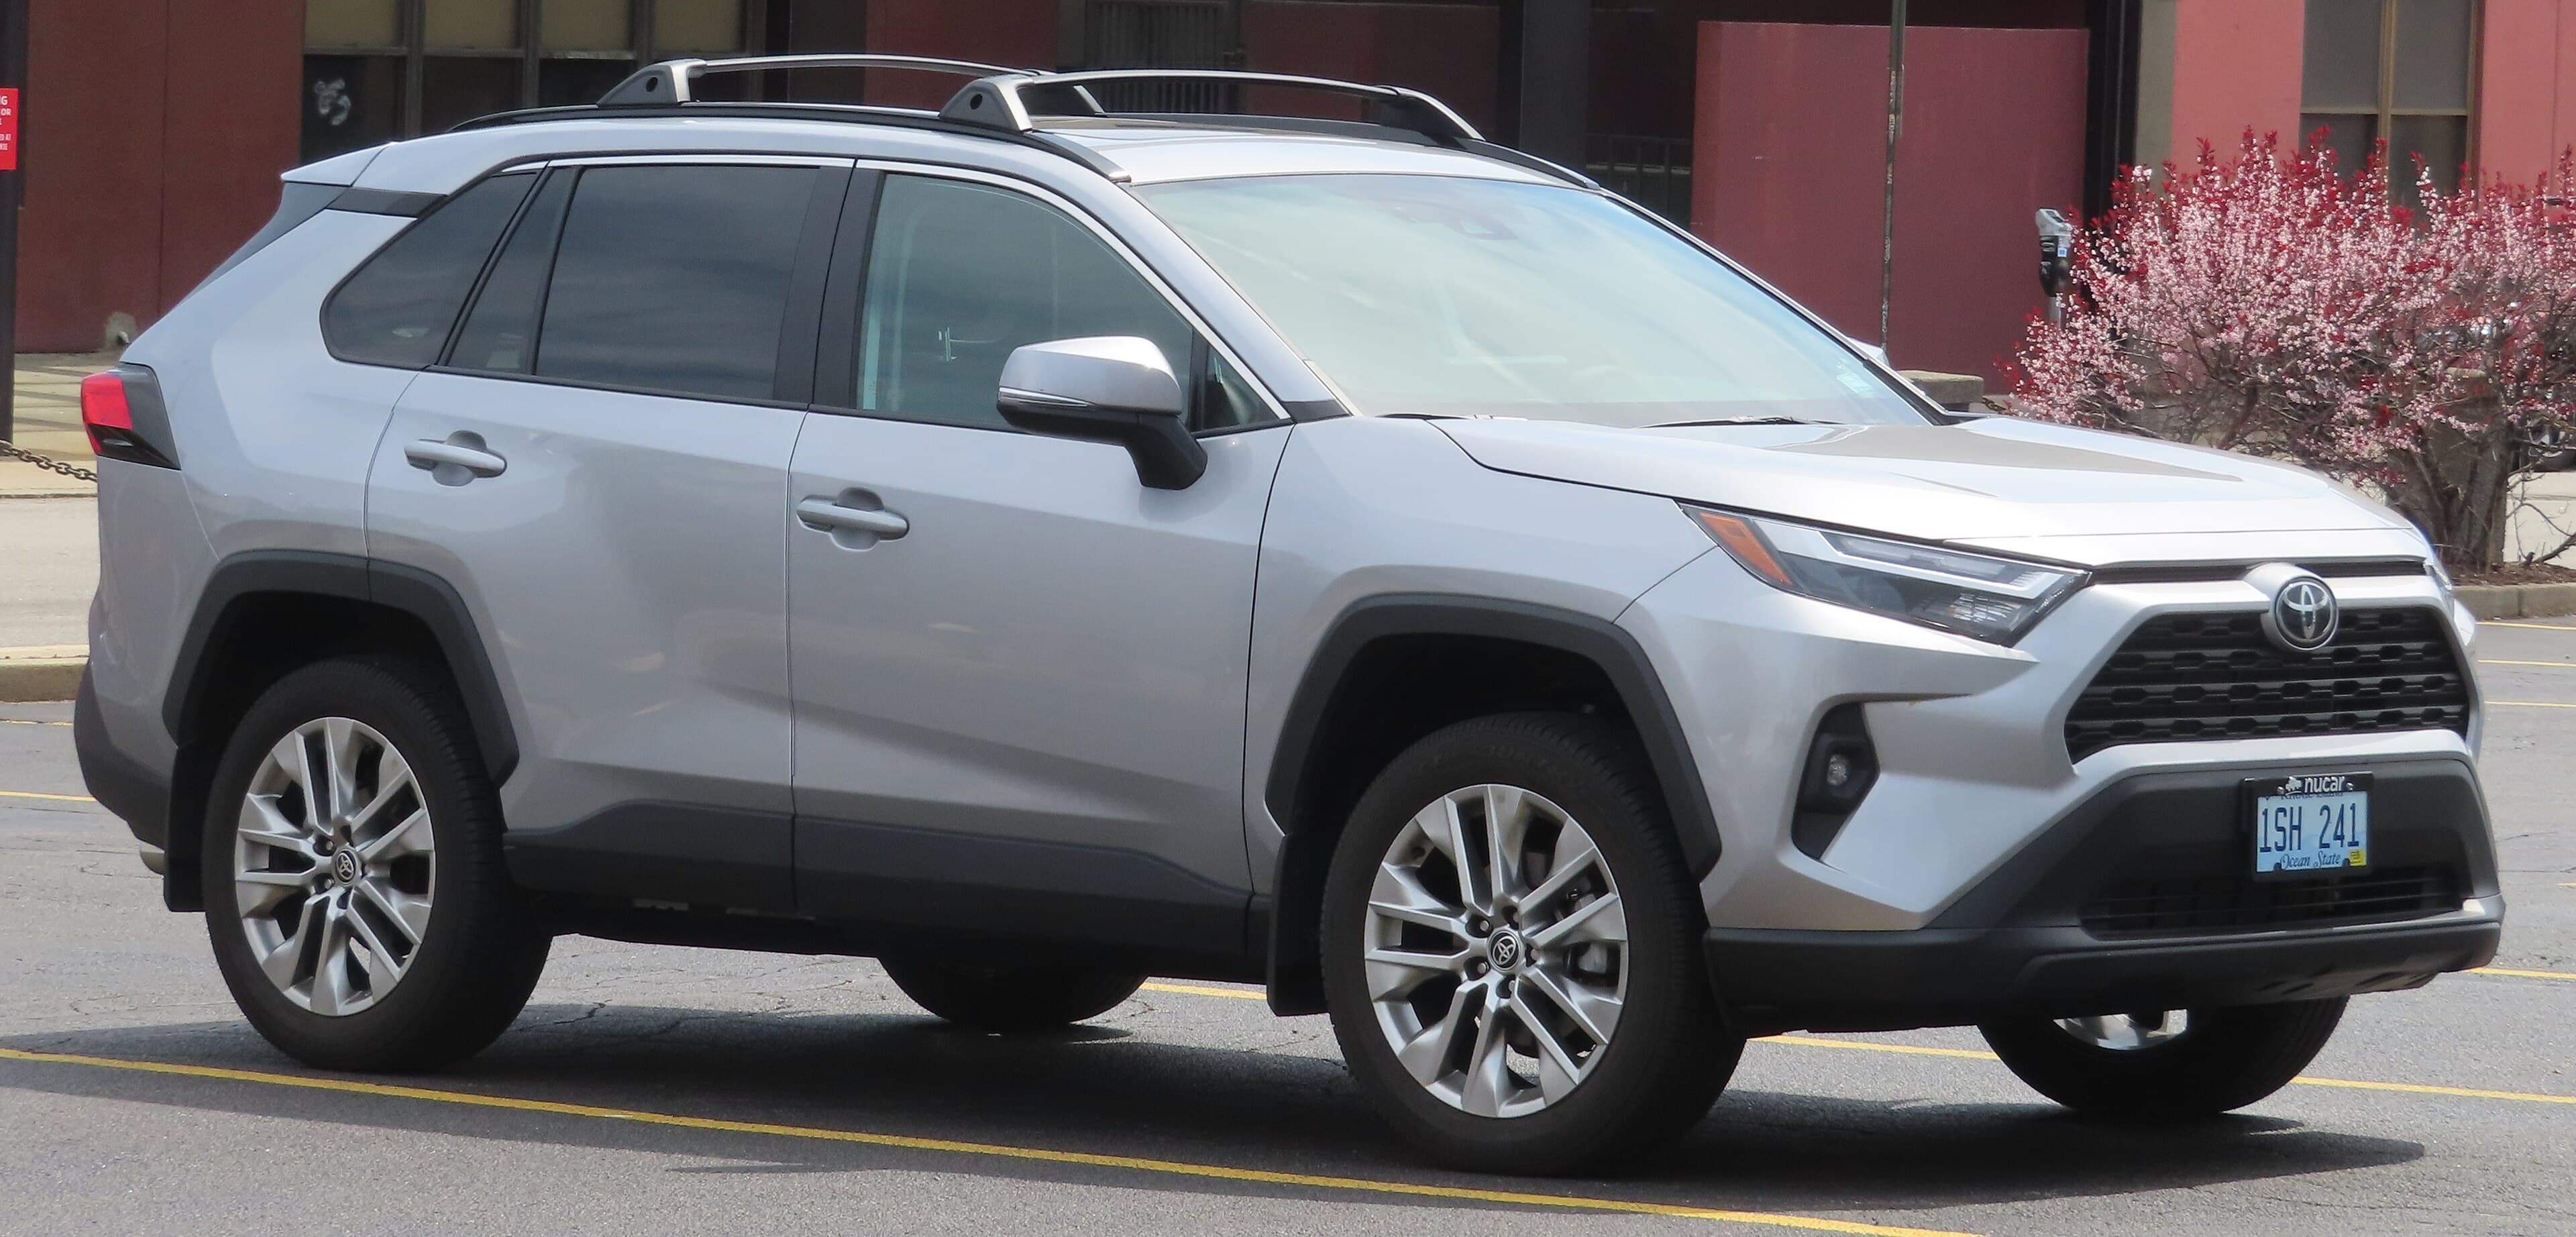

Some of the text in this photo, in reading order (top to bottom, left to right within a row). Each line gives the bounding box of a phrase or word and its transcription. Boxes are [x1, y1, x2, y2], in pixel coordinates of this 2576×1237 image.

[2304, 776, 2345, 792] nucar
[2259, 803, 2359, 853] 1SH 241
[2282, 854, 2310, 868] Ocean
[2314, 851, 2341, 868] State
